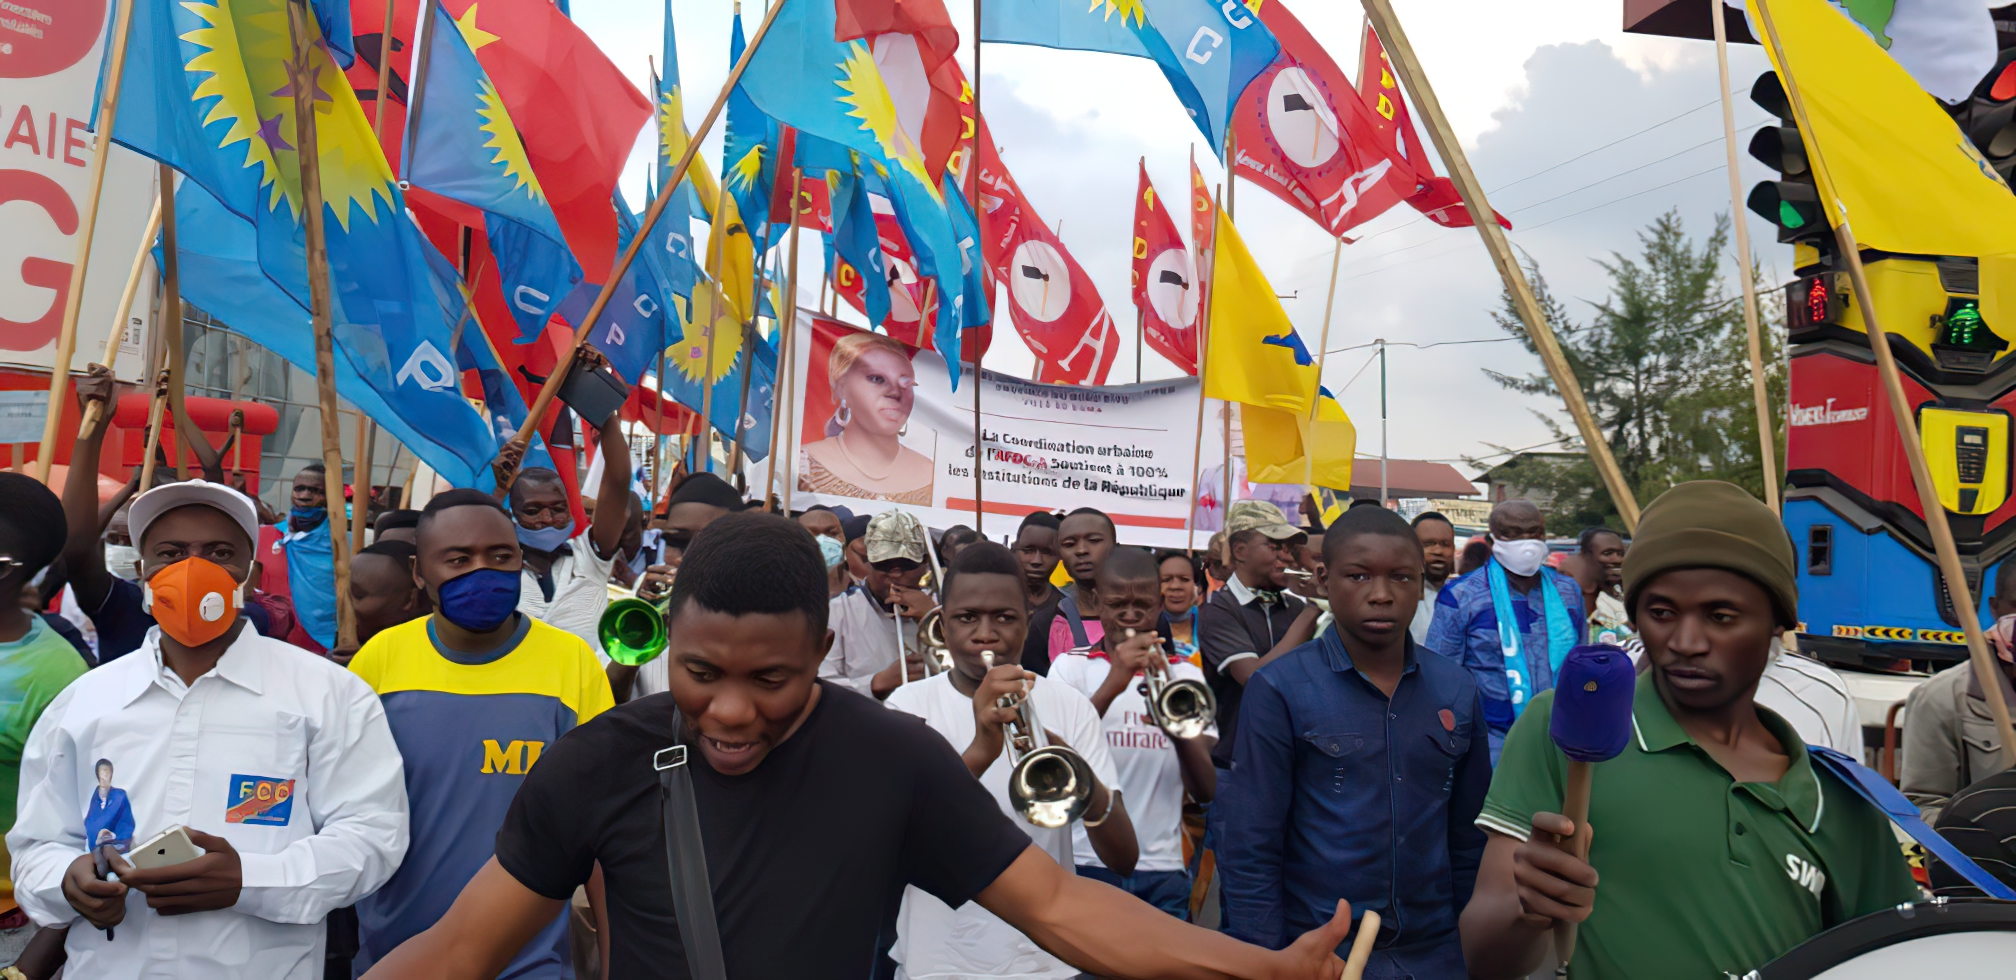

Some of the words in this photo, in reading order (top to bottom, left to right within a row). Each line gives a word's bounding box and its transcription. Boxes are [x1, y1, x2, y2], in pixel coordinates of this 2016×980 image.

[0, 104, 86, 168] AIE
[396, 340, 455, 392] P
[982, 429, 999, 443] La
[1003, 433, 1095, 455] Coordination
[1098, 445, 1154, 459] urbaine
[948, 463, 969, 478] les
[1062, 476, 1081, 490] de
[1084, 478, 1098, 491] la
[1130, 466, 1169, 478] 100%
